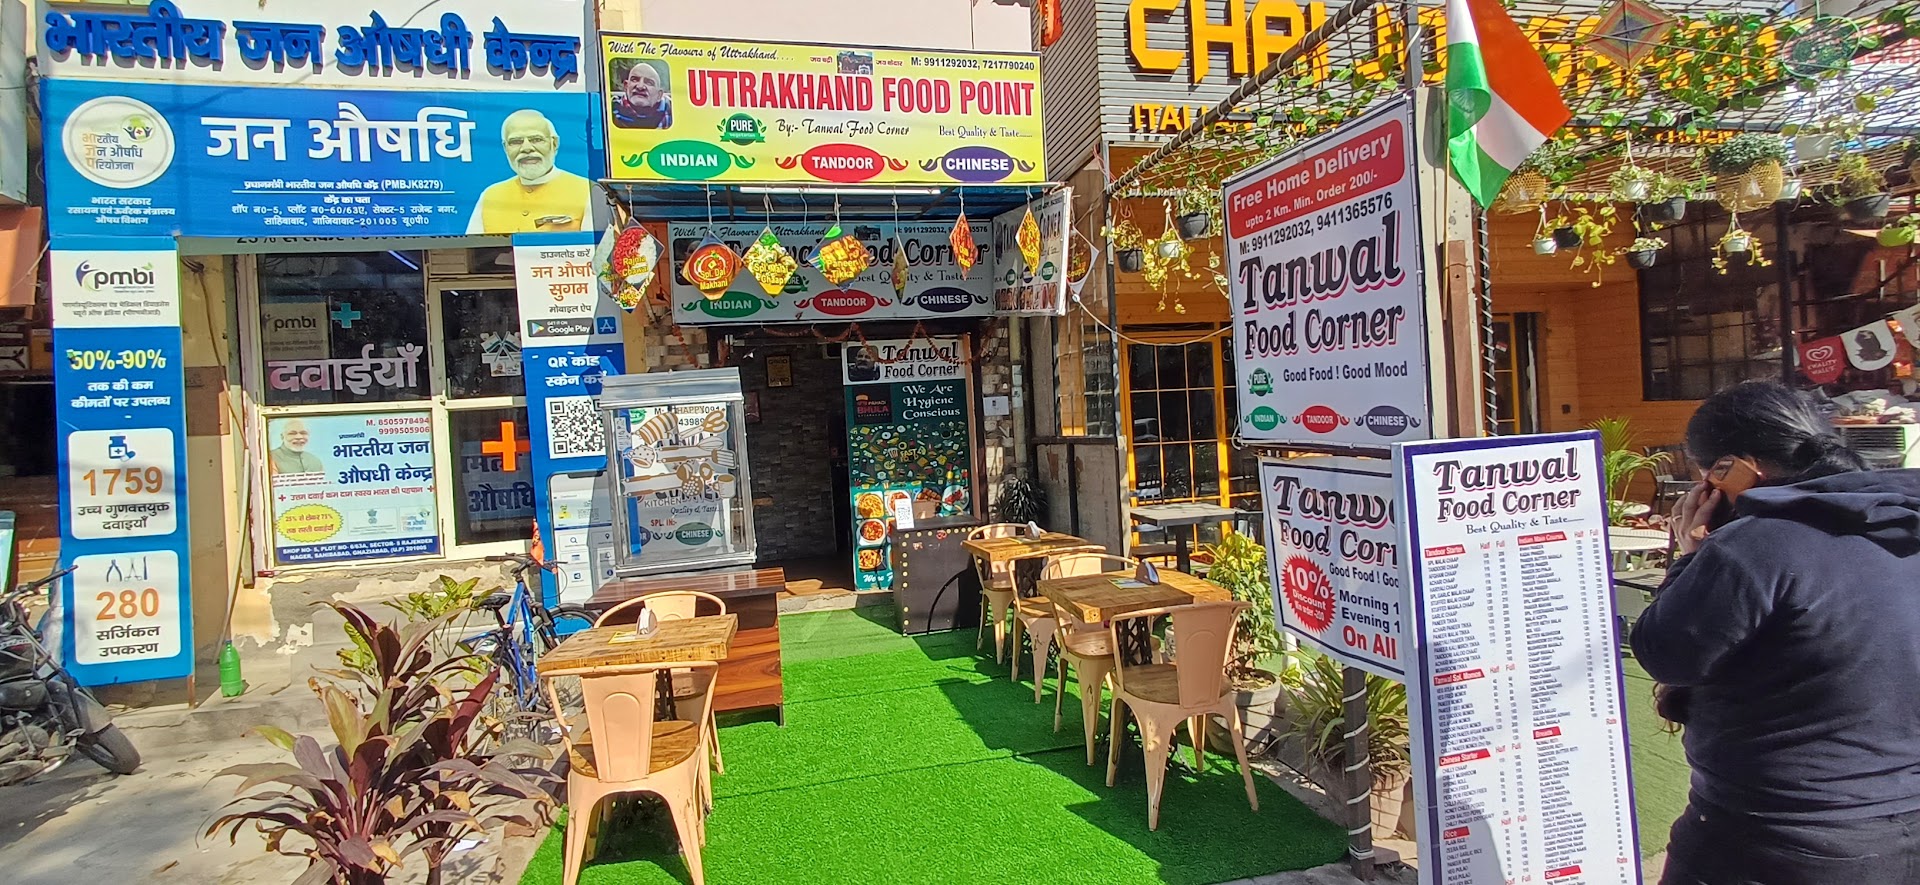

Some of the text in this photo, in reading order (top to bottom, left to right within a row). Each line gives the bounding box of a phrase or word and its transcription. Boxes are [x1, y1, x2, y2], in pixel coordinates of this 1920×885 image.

[45, 0, 226, 66] भारतीय
[233, 20, 326, 68] जन
[483, 16, 581, 84] केन्द्र
[608, 41, 635, 53] With
[637, 42, 657, 54] The
[660, 44, 703, 57] Flavours
[706, 47, 717, 61] of
[911, 57, 1035, 71] M: 9911292032, 7217790240
[688, 68, 1034, 116] UTTRAKHAND FOOD POINT
[201, 101, 476, 162] जन औषधि
[730, 118, 753, 132] PURE
[801, 118, 843, 135] Tanwal
[846, 120, 874, 138] Food
[877, 121, 909, 136] Corner
[939, 125, 997, 139] Best Quality &
[82, 132, 119, 144] भारतीय
[84, 144, 107, 157] जन
[86, 157, 134, 170] परियोजना
[660, 153, 718, 167] INDIAN
[812, 156, 874, 170] TANDOOR
[946, 157, 1009, 171] CHINESE
[1233, 133, 1393, 213] Free Home Delivery
[285, 180, 317, 189] भारतीय
[381, 180, 443, 191] (PMBJK8279)
[1245, 168, 1378, 229] upto 2 Km. Min. Order 200/-
[231, 205, 248, 214] शॉप
[1239, 191, 1393, 256] M: 9911292032, 9411365576
[673, 226, 698, 237] With
[720, 226, 758, 238] Flavours
[826, 259, 858, 269] Paneer
[1238, 210, 1406, 314] Tanwal
[95, 265, 154, 289] pmbi
[530, 265, 553, 279] जन
[714, 268, 726, 277] Dal
[831, 269, 854, 280] Tikka
[700, 278, 728, 290] Makhani
[548, 282, 589, 302] सुगम
[709, 300, 752, 310] INDIAN
[821, 297, 867, 307] TANDOOR
[920, 294, 968, 305] CHINESE
[274, 314, 316, 331] pmbi
[547, 322, 591, 335] Google Play
[1244, 304, 1406, 359] Food Corner
[882, 342, 959, 363] Tanwal
[548, 357, 568, 368] QR
[1807, 358, 1837, 370] KWALITY
[884, 363, 960, 378] Food Corner
[1283, 360, 1408, 382] Good Food Good Mood
[88, 378, 153, 391] तक की कम
[1253, 372, 1267, 385] PURE
[902, 384, 954, 395] We Are
[71, 396, 170, 408] कीमतों पर उपलब्ध
[902, 396, 954, 410] Hygiene
[902, 408, 961, 420] Conscious
[1254, 414, 1274, 423] INDIAN
[1306, 414, 1334, 425] TANDOOR
[1368, 415, 1405, 427] CHINESE
[366, 417, 430, 427] M. 8505978494
[378, 427, 430, 435] 9999505906
[333, 437, 430, 458] भारतीय जन
[338, 463, 391, 485] औषधी
[395, 463, 433, 483] केन्द्र
[1433, 447, 1581, 496] Tanwal
[83, 466, 163, 496] 1759
[78, 504, 102, 516] उच्च
[1437, 488, 1582, 523] Food Corner
[1466, 517, 1540, 535] Best Quality &
[681, 529, 710, 538] CHINESE
[1279, 518, 1331, 557] Food
[1329, 562, 1375, 583] Good Food
[1287, 563, 1330, 600] 10%
[96, 588, 160, 621] 280
[1292, 587, 1326, 611] Discount
[1339, 589, 1388, 615] Morning
[1341, 607, 1390, 633] Evening
[96, 623, 161, 641] सर्जिकल
[99, 642, 159, 657] उपकरण
[1343, 625, 1397, 660] On All
[1511, 742, 1522, 750] Full
[1517, 814, 1528, 823] Full
[1444, 829, 1458, 839] Rice
[1546, 869, 1561, 878] Soup
